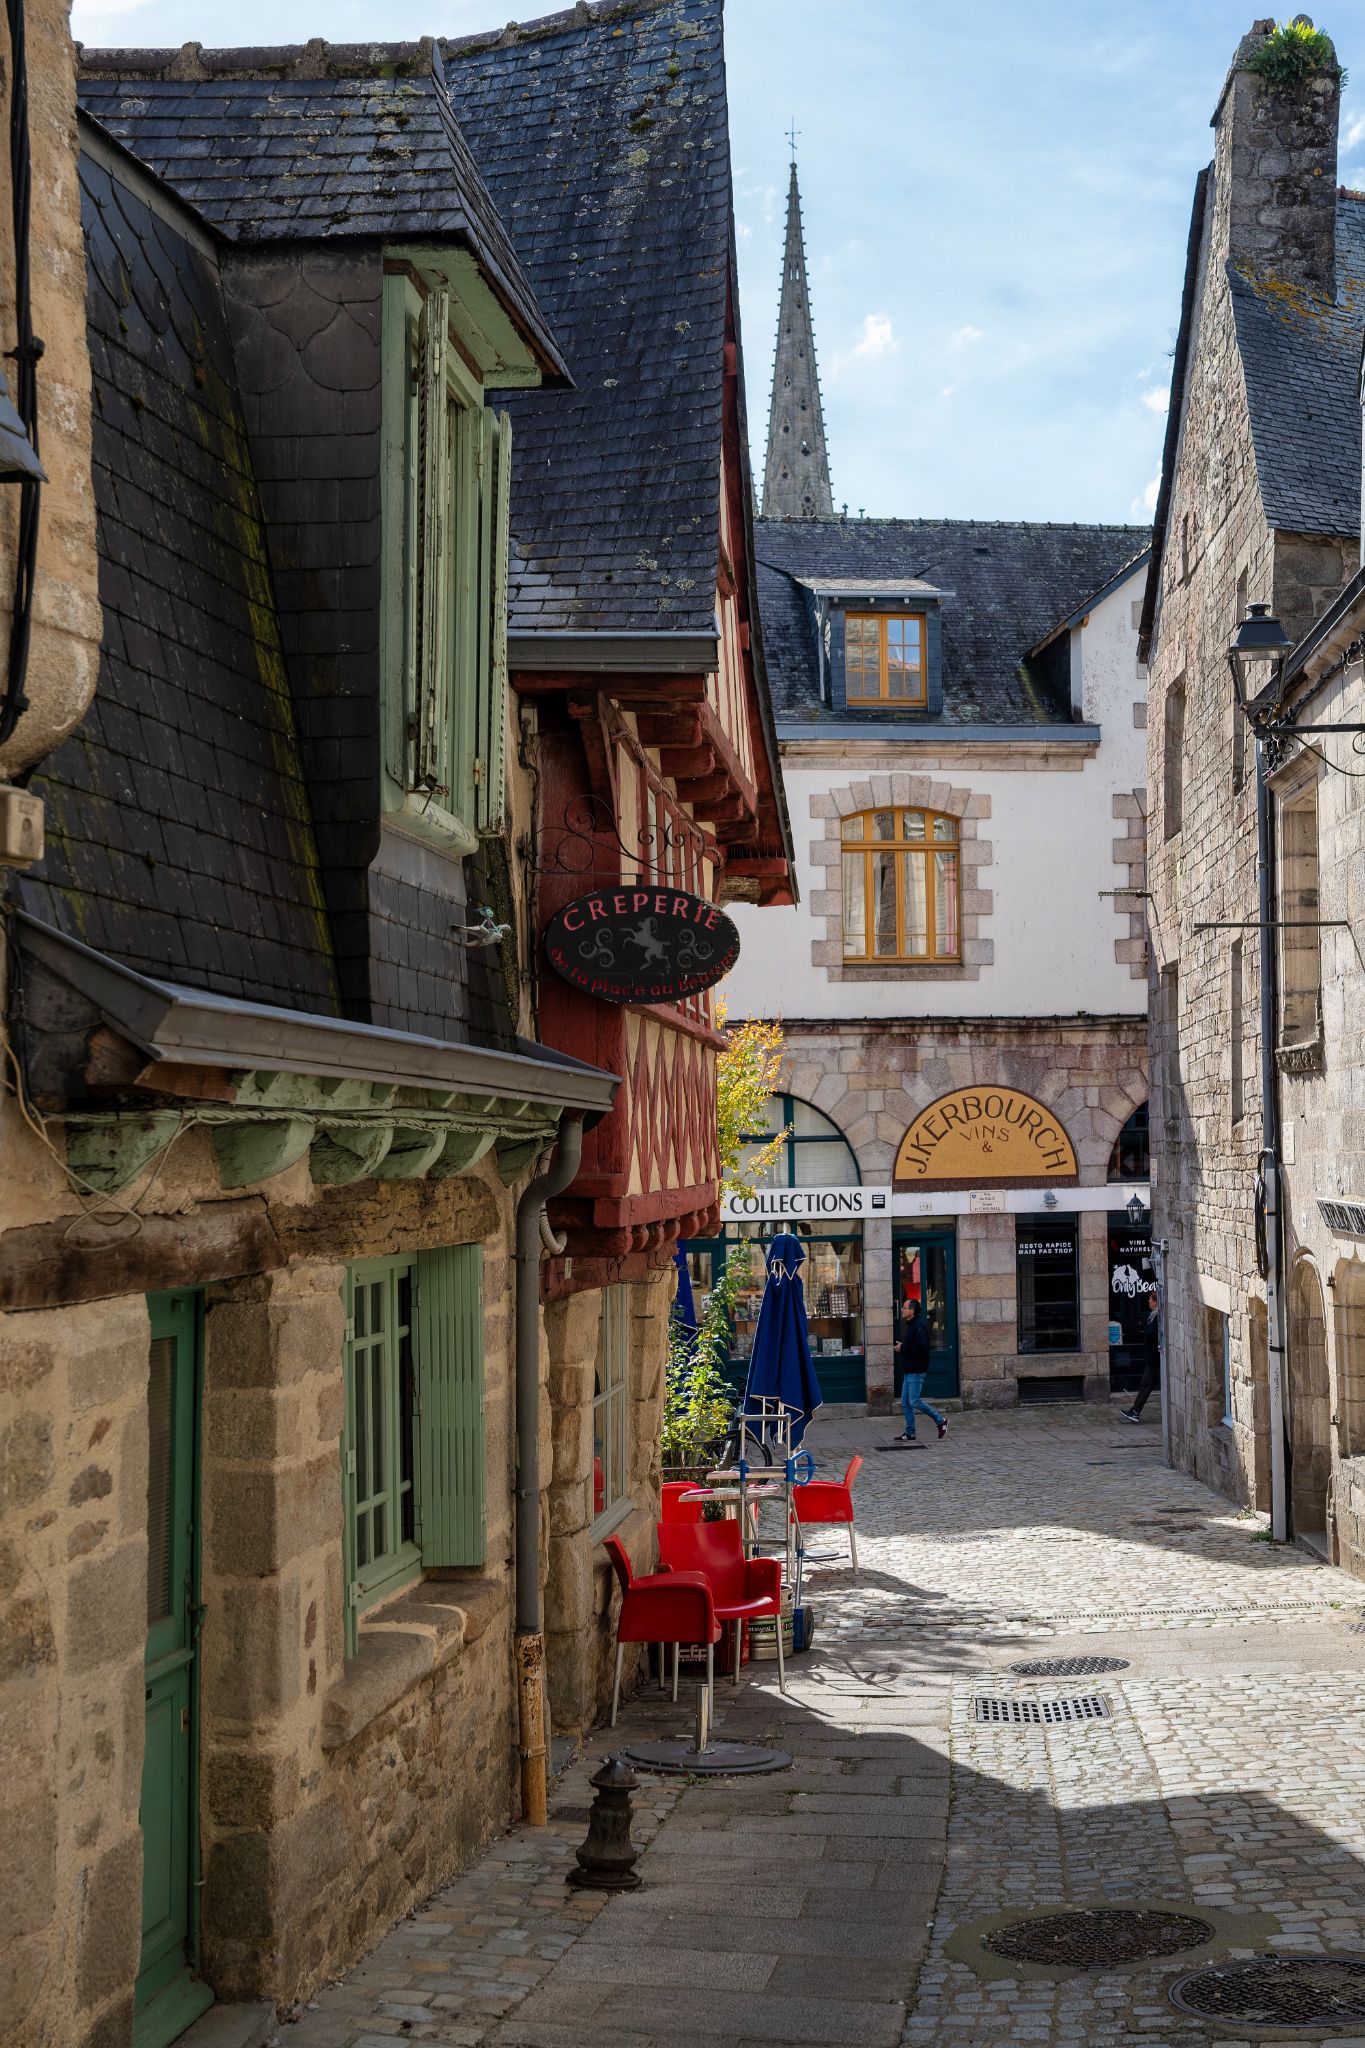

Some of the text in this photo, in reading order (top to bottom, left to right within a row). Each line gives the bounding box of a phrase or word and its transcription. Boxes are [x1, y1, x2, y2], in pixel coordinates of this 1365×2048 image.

[563, 892, 722, 931] CREPERIE
[591, 979, 646, 996] place
[959, 1125, 1010, 1142] VINS
[981, 1140, 993, 1153] &
[730, 1192, 863, 1215] COLLECTIONS
[1112, 1278, 1136, 1299] Only
